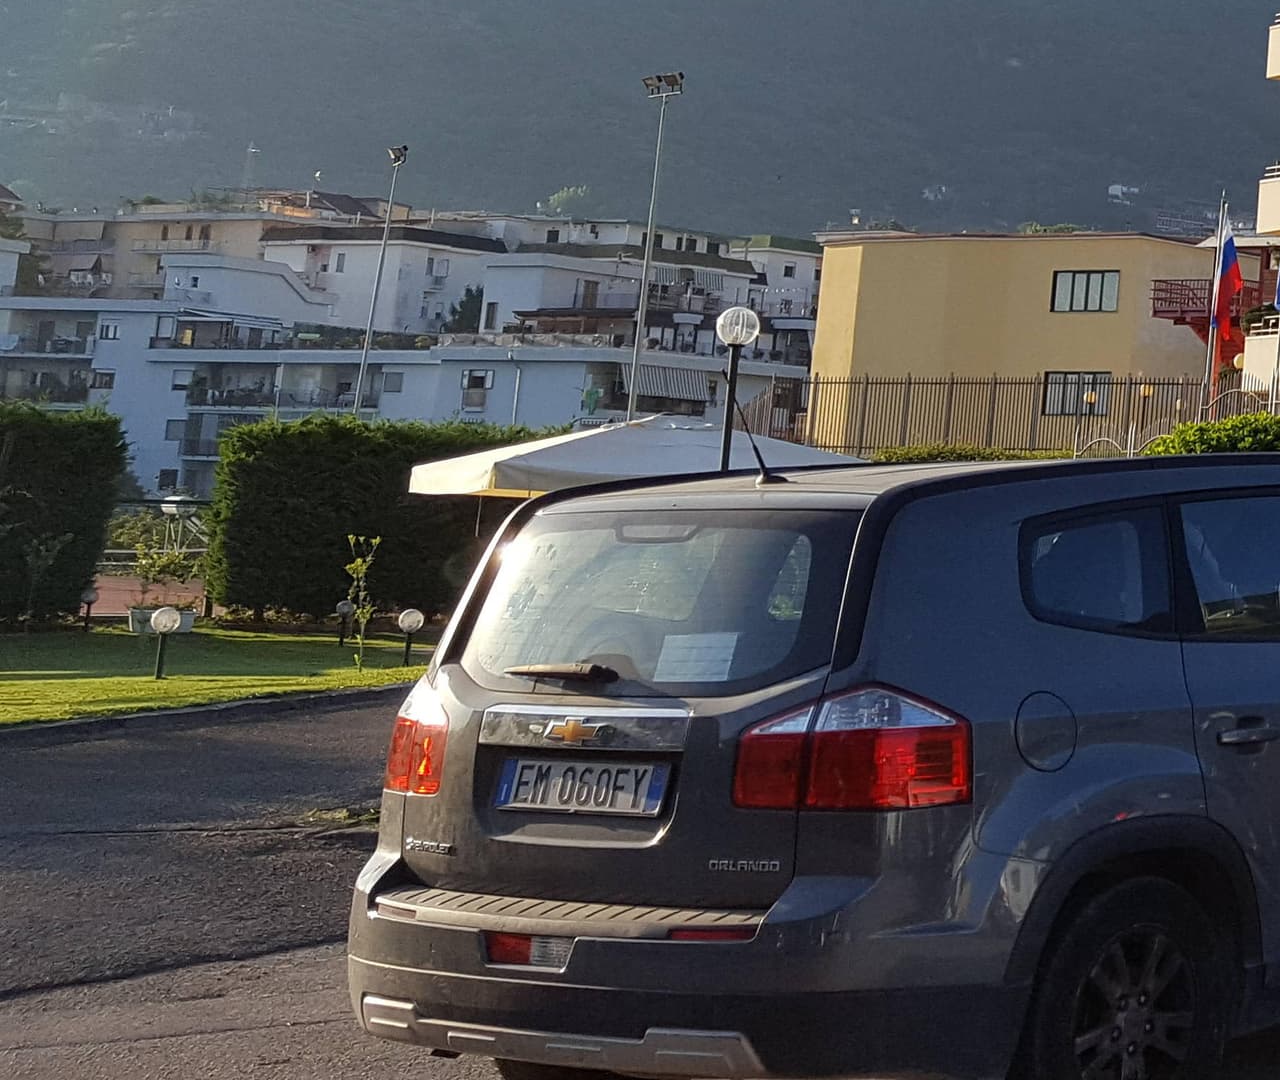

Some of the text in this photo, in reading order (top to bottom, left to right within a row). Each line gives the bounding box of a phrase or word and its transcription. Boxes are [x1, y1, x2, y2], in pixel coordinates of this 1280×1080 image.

[513, 764, 552, 805] EM
[557, 766, 648, 809] 060FY
[708, 859, 781, 872] ORLANDO
